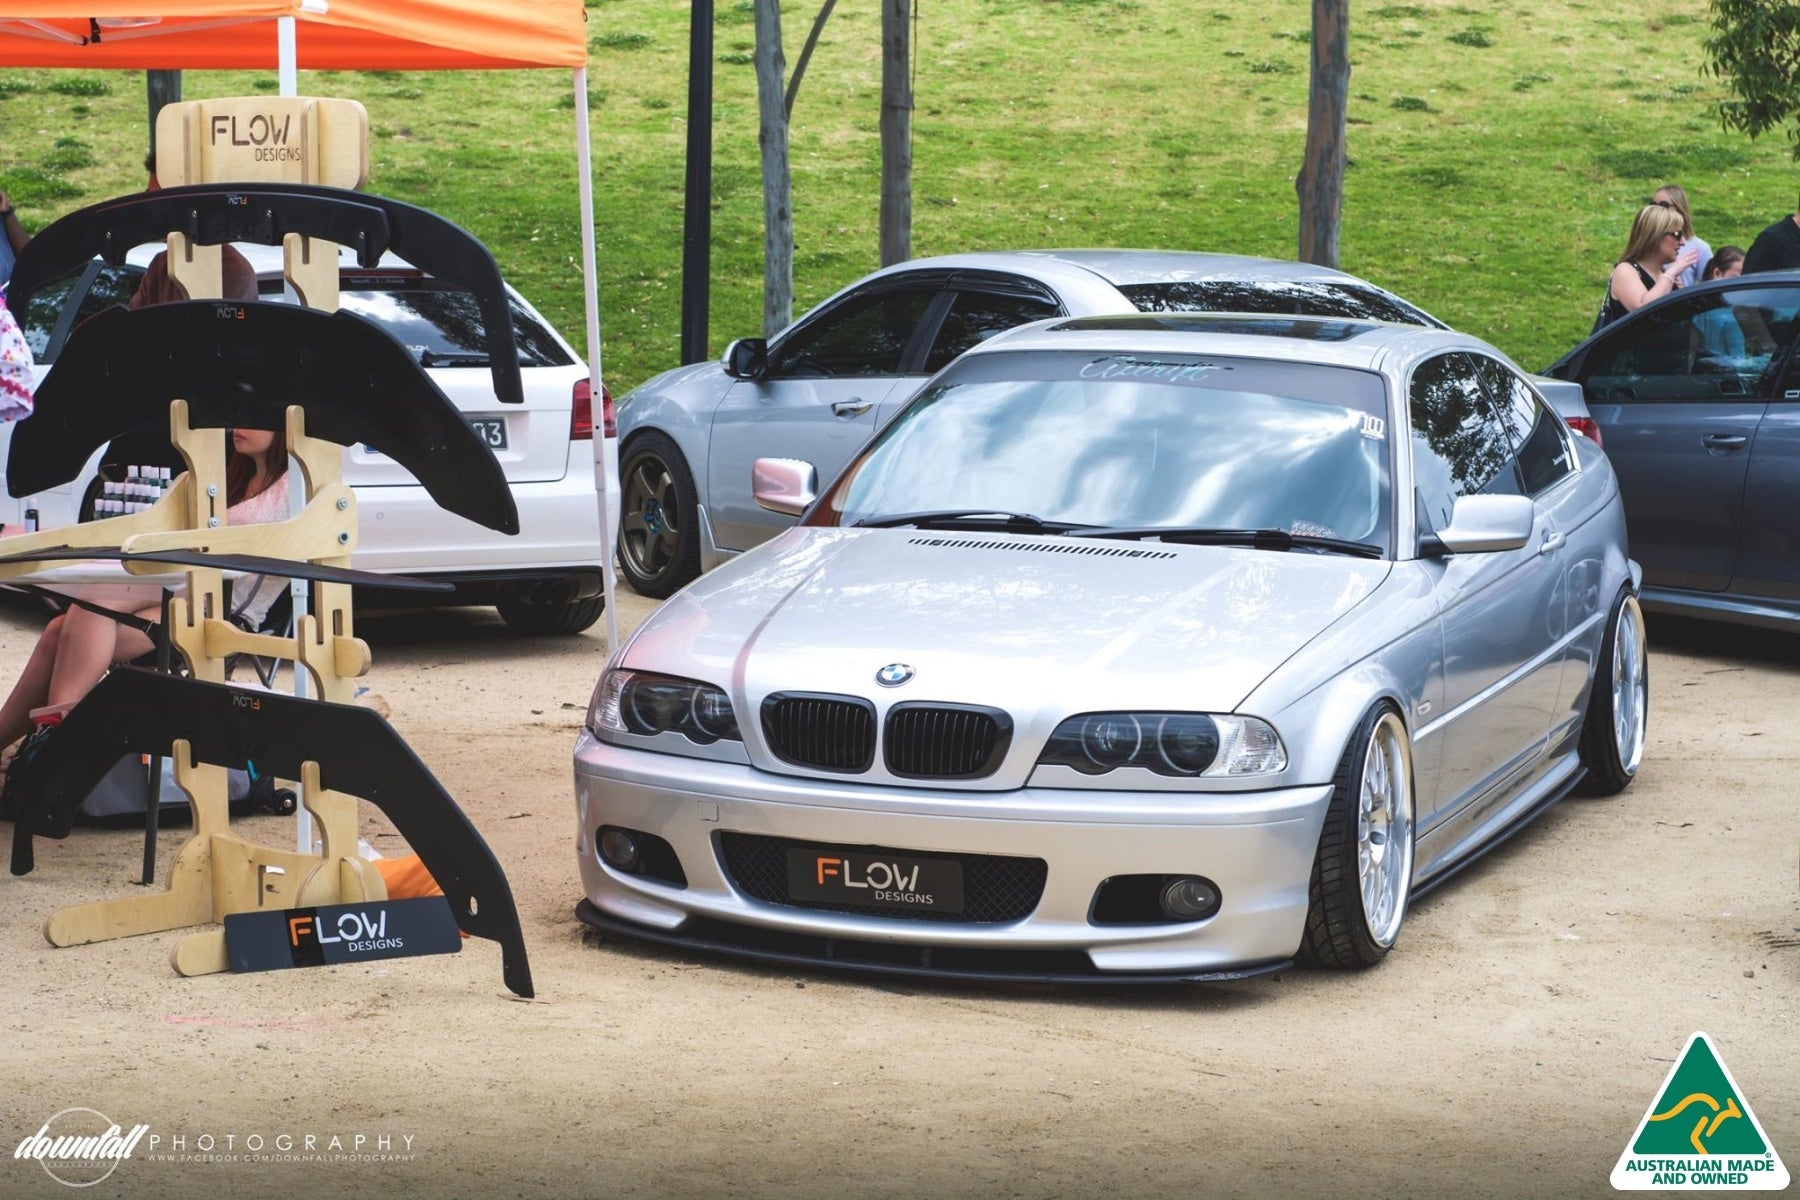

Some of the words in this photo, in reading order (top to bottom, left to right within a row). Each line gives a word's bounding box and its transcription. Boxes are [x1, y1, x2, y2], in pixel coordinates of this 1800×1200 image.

[211, 114, 290, 146] FLOW
[255, 147, 301, 161] DESIGNS
[217, 307, 245, 320] FLOW
[232, 695, 260, 710] FLOW
[817, 857, 919, 892] FLOW
[875, 890, 934, 905] DESIGNS
[289, 910, 386, 947] FLOW
[348, 937, 404, 952] DESIGNS
